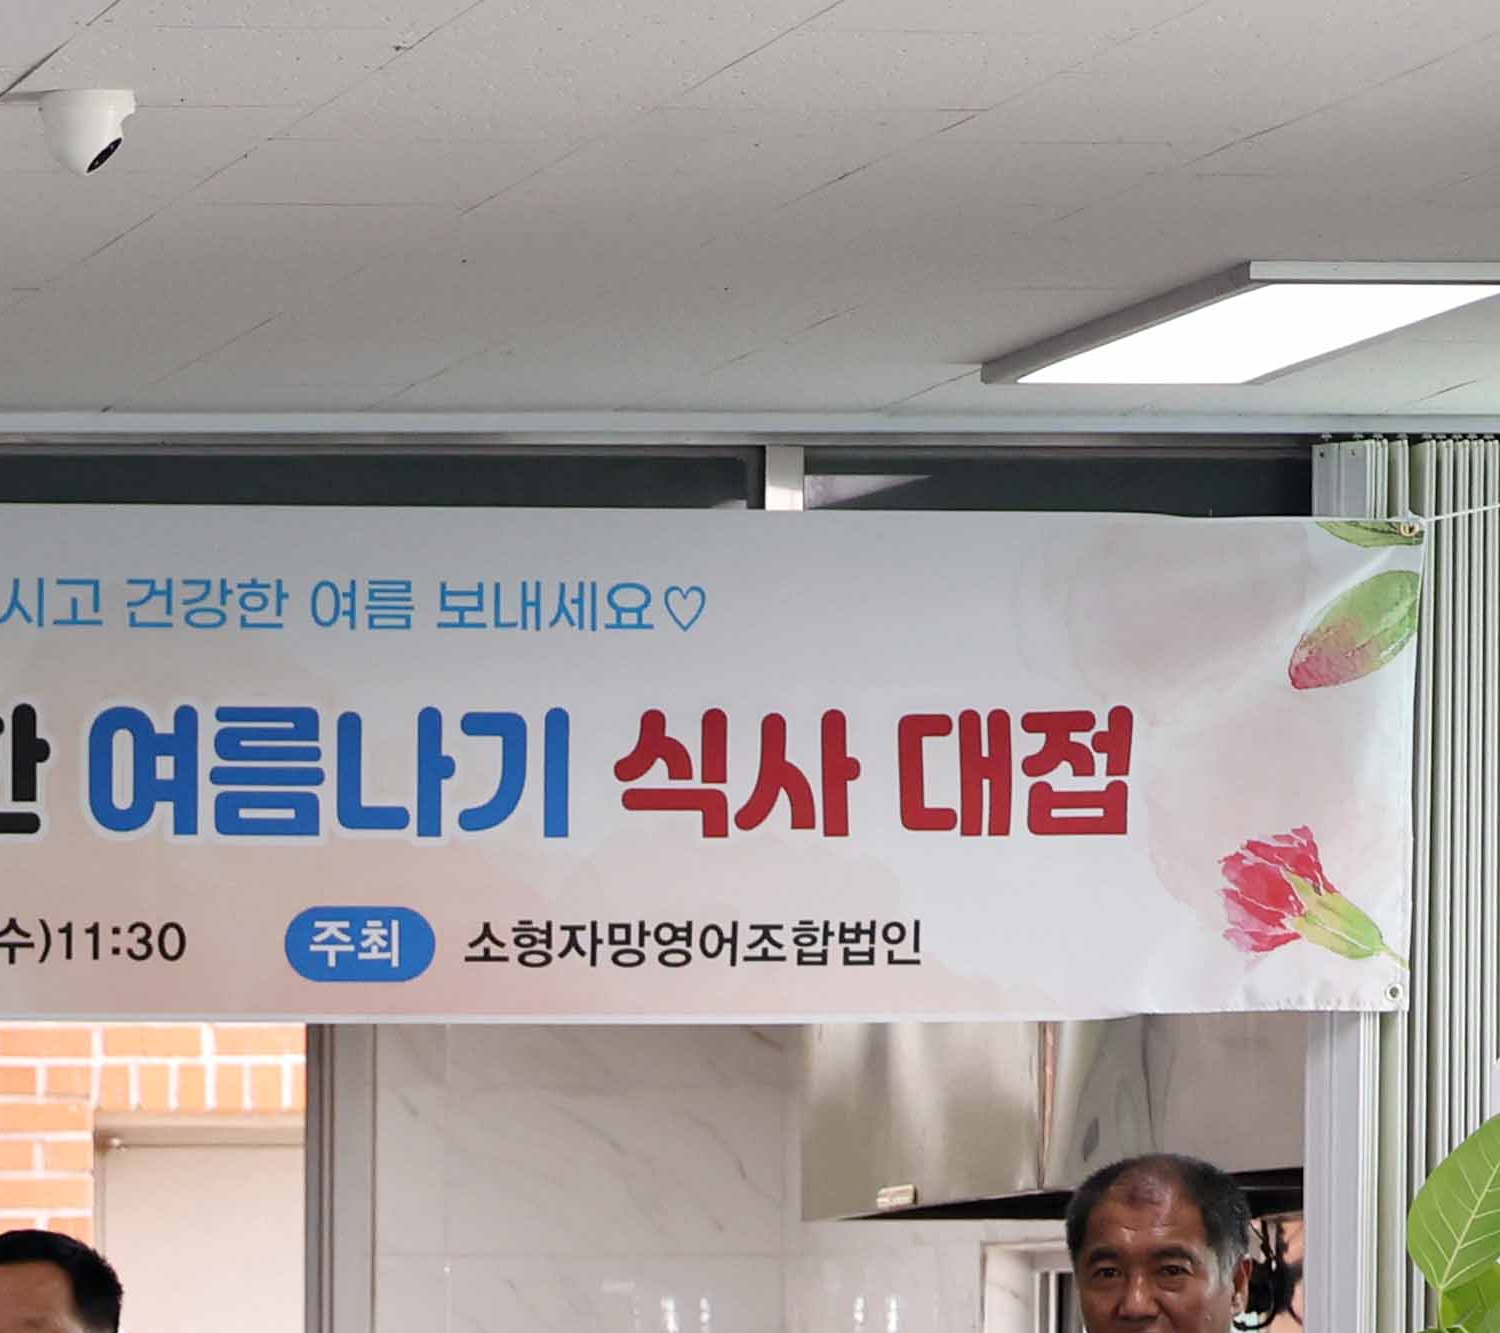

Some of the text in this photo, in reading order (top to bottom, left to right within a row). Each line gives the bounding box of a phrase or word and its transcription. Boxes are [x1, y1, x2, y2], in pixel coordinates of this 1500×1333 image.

[126, 577, 292, 632] 건강한
[309, 578, 415, 633] 여름
[436, 579, 656, 633] 보내세요
[89, 705, 571, 839] 여름나기
[613, 708, 863, 839] 식사
[898, 705, 1135, 839] 대접
[308, 918, 923, 970] 주최 소형자망영어조합법인
